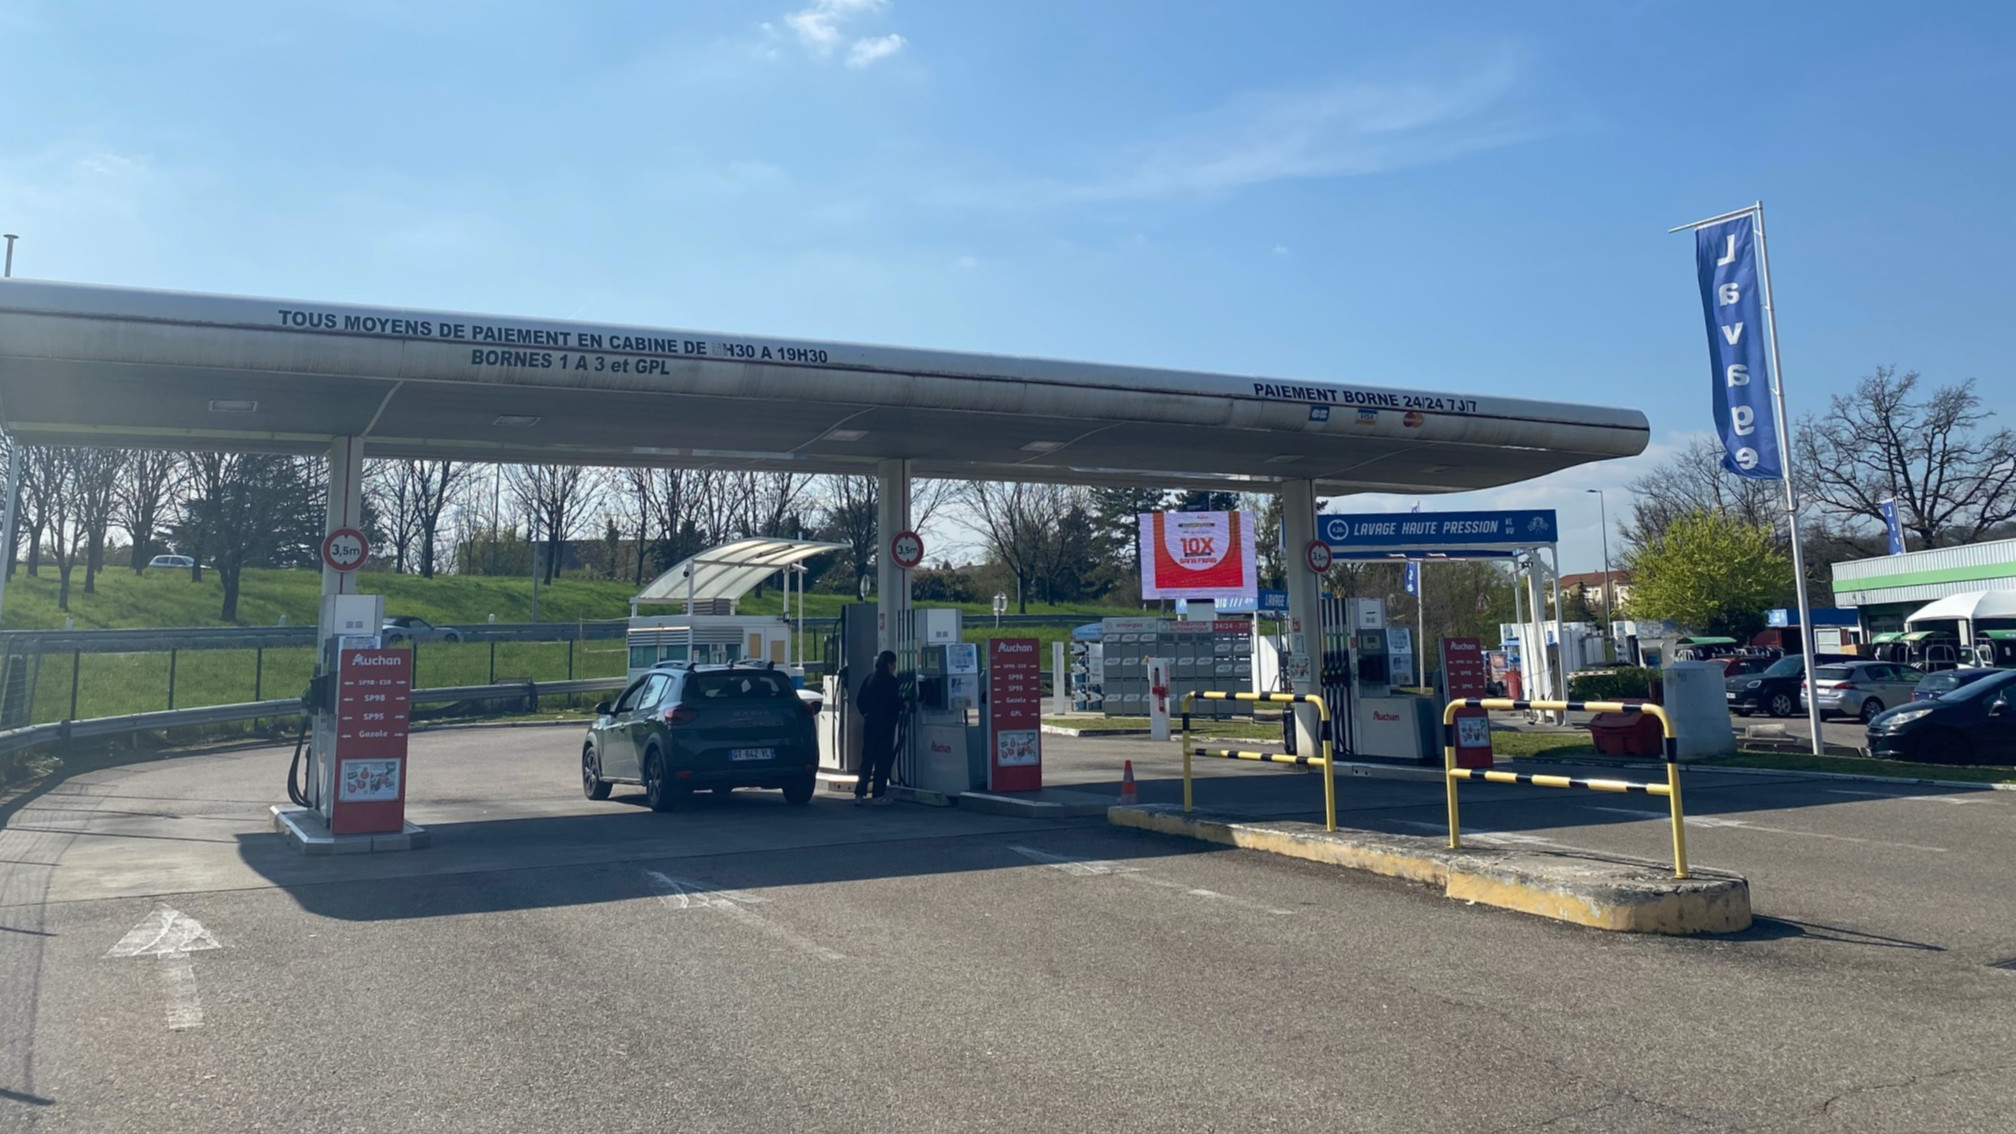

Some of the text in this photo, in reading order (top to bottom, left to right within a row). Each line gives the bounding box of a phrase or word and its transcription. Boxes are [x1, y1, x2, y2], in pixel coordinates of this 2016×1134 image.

[278, 310, 337, 329] TOUS
[344, 315, 432, 336] MOYENS
[439, 322, 465, 339] DE
[472, 325, 571, 347] PAIEMENT
[578, 333, 602, 349] EN
[609, 335, 678, 354] CABINE
[684, 340, 707, 356] DE
[761, 345, 773, 360] A
[777, 346, 828, 364] 19H30
[471, 349, 670, 376] BORNES 1 A 3 et GPL
[1253, 383, 1337, 403] PAIEMENT
[1343, 390, 1400, 408] BORNE
[1403, 395, 1444, 410] 24/24
[1354, 522, 1397, 536] LAVAGE
[1401, 521, 1438, 535] HAUTE
[1443, 520, 1499, 534] PRESSION
[331, 545, 360, 557] 3,5m
[897, 545, 918, 555] 3,5m
[1180, 537, 1215, 554] 10X
[1312, 551, 1328, 561] 3,5m
[1264, 594, 1285, 607] LAVAGE
[1214, 622, 1233, 630] 24/24
[1238, 622, 1249, 630] 7/7
[998, 642, 1032, 653] Auchan
[1450, 641, 1477, 650] Auchan
[351, 653, 401, 666] Auchan
[364, 694, 386, 702] SP98
[1005, 696, 1027, 704] Gazole
[363, 712, 384, 721] SP95
[1010, 709, 1023, 717] GPL
[1373, 710, 1400, 722] Auchan
[358, 729, 388, 738] Gazole
